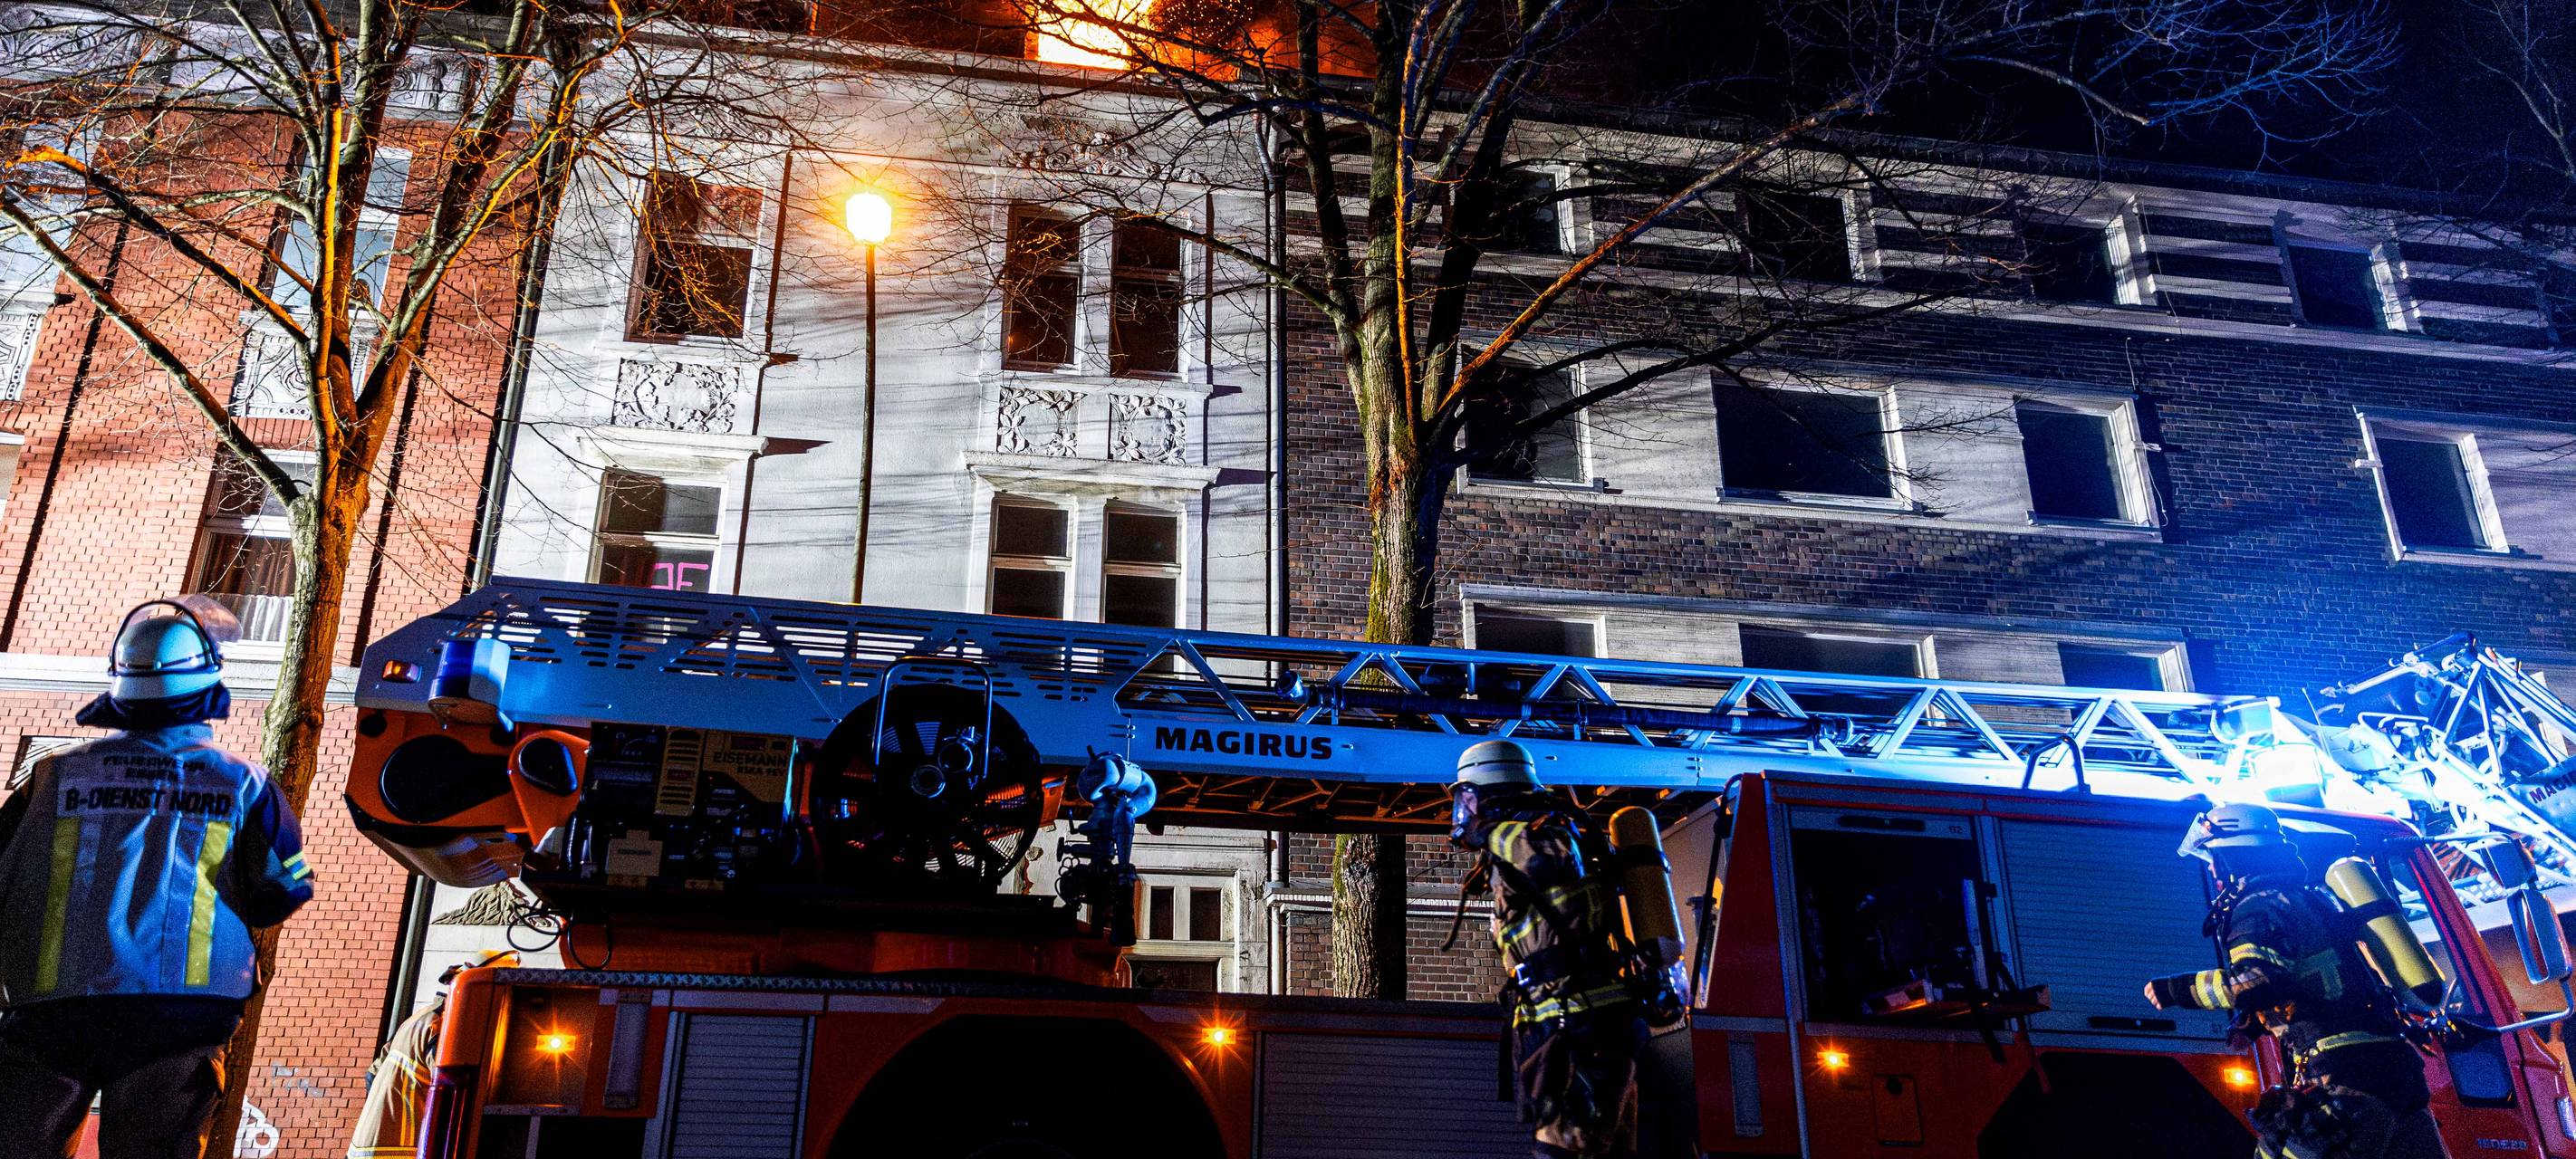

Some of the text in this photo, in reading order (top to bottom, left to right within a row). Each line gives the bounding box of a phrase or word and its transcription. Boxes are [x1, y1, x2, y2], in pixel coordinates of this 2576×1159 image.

[1155, 726, 1332, 761] MAGIRUS
[713, 752, 788, 767] EISEMANN
[65, 787, 232, 815] B-DIENST NORD
